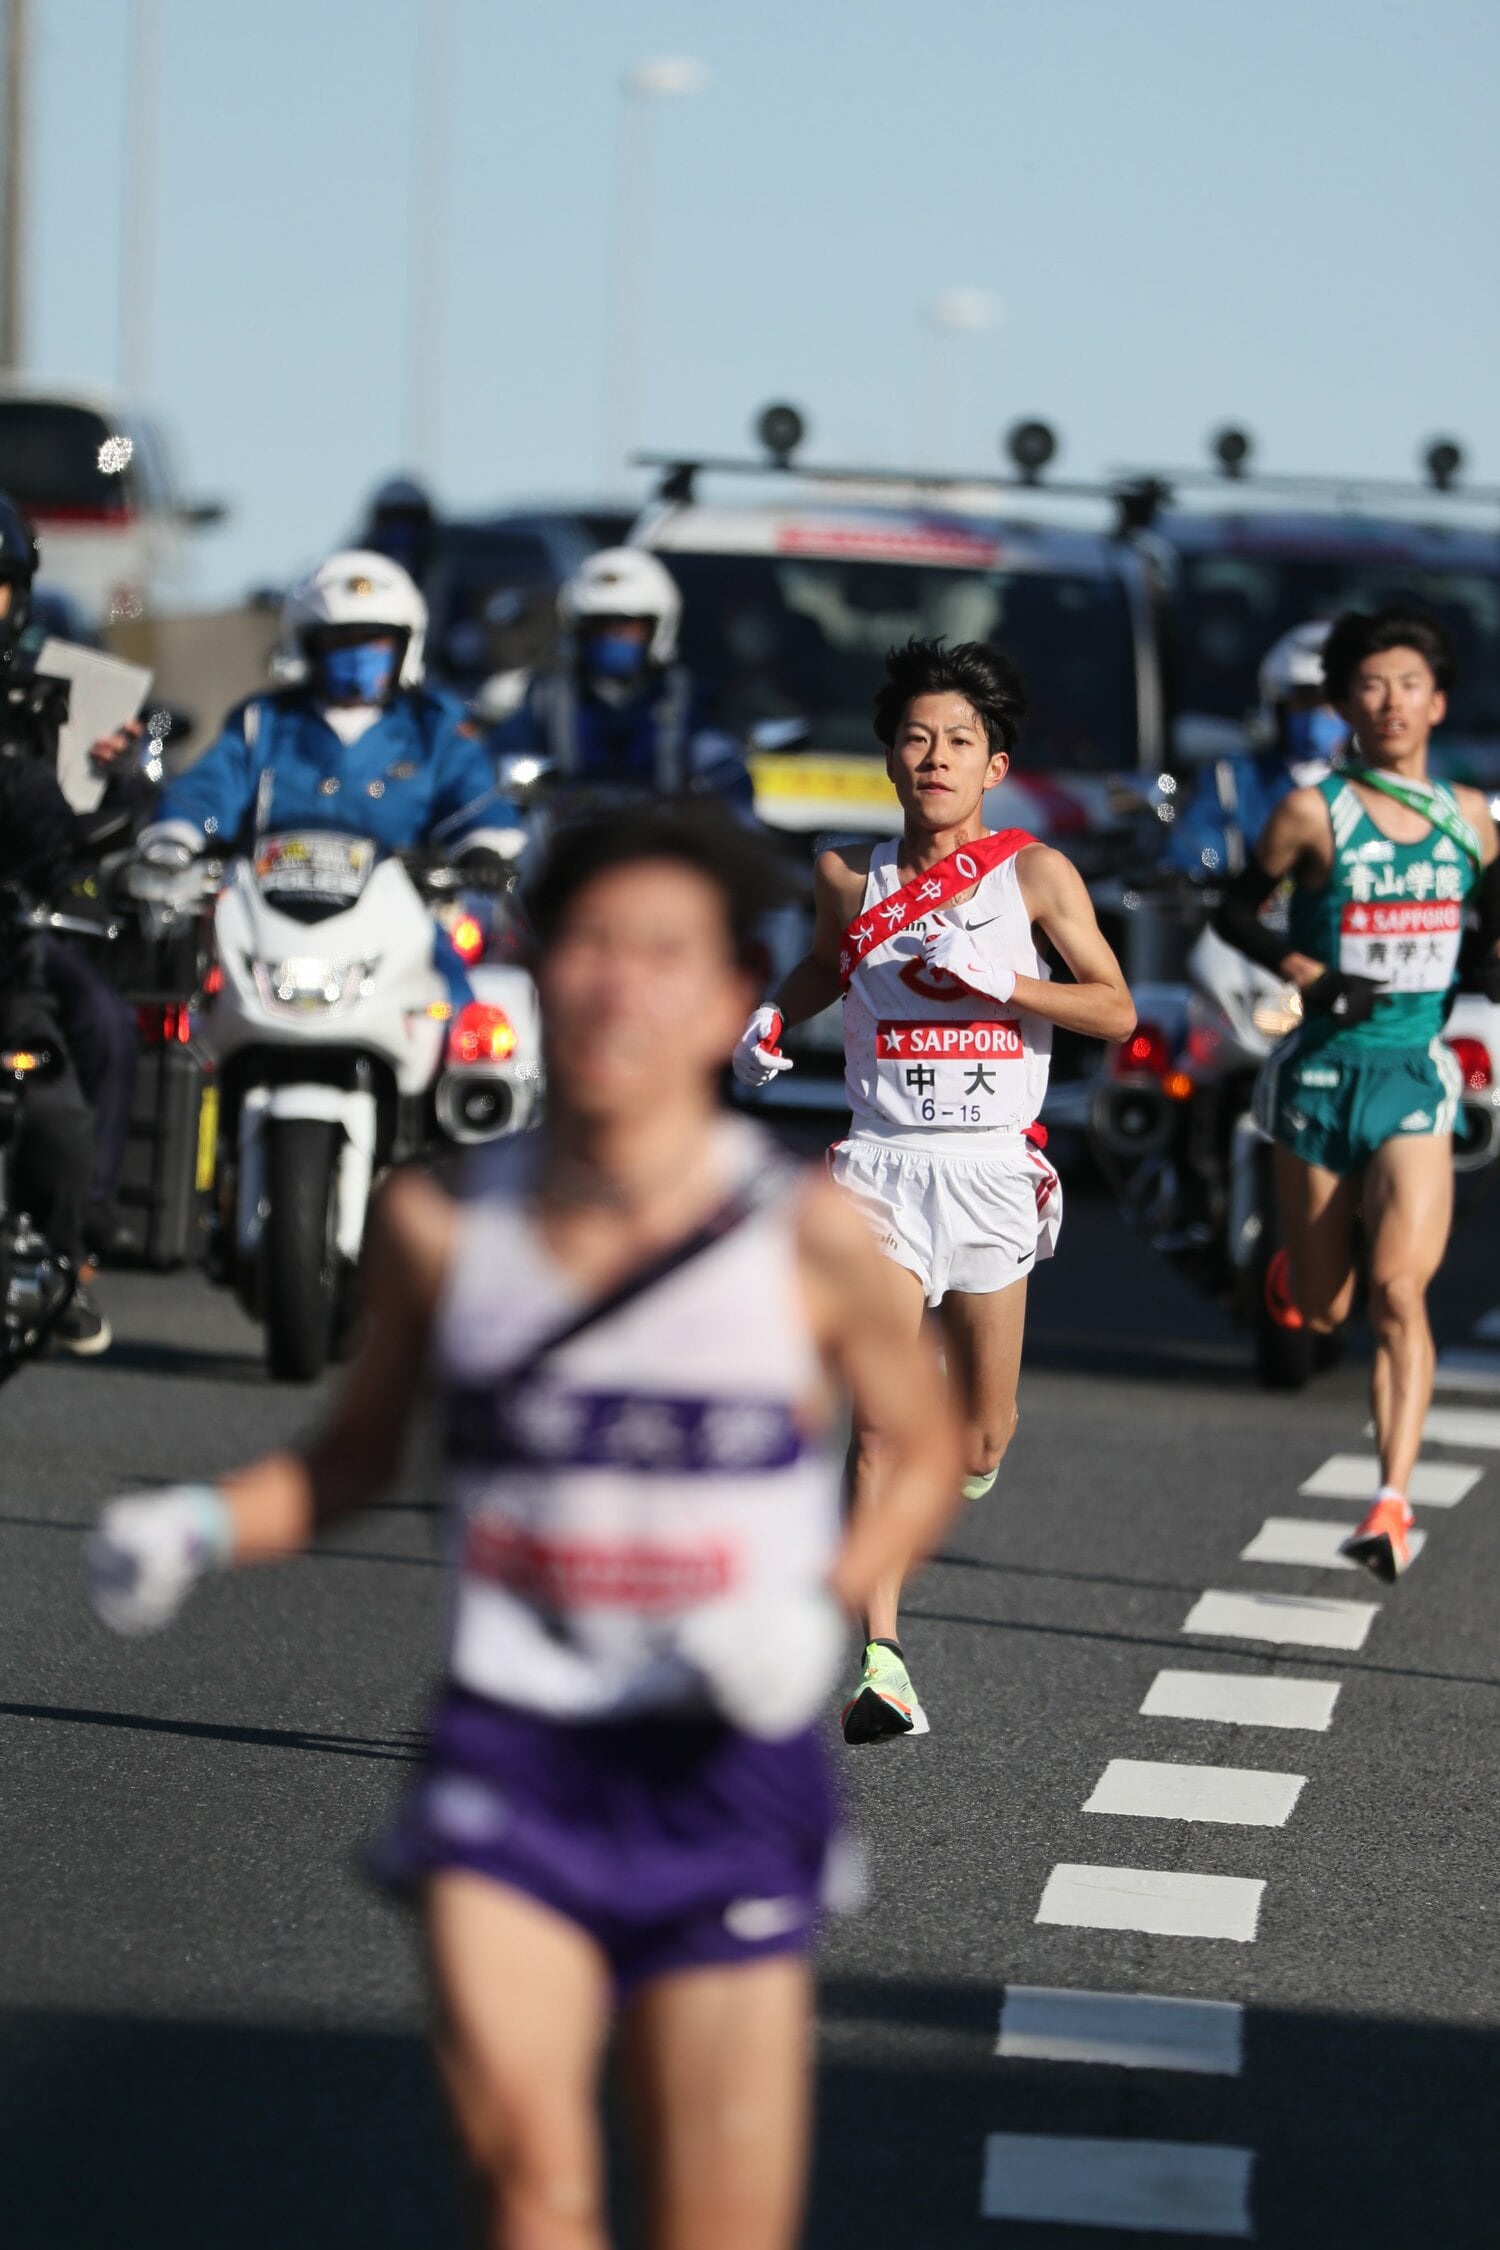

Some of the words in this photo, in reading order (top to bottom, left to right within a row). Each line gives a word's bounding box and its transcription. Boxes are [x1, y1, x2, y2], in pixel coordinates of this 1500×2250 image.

[1344, 861, 1463, 903] 青山学院
[1372, 904, 1458, 931] SAPPORO
[910, 1029, 1019, 1052] SAPPORO
